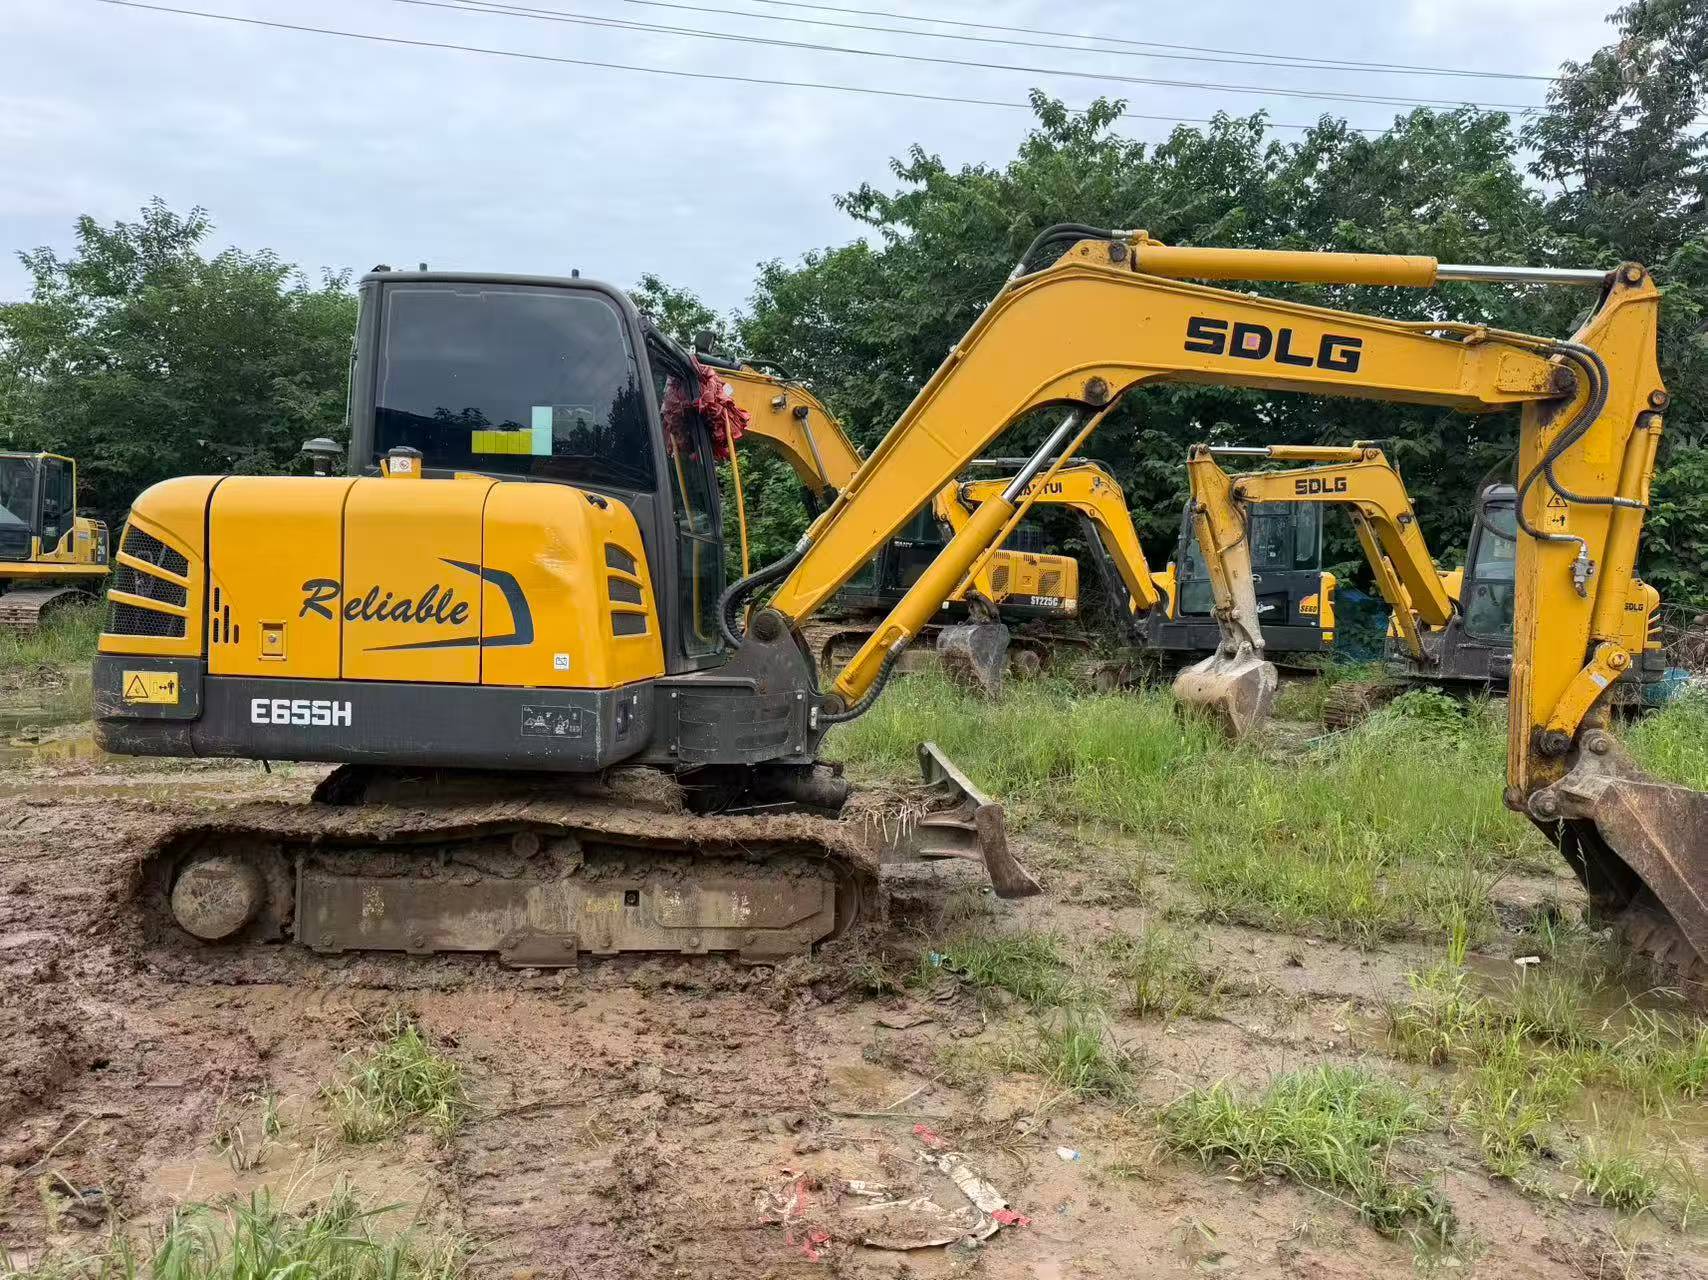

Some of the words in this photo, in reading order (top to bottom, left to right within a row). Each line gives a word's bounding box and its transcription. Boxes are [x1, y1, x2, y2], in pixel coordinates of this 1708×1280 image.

[1184, 316, 1363, 373] SDLG
[1295, 476, 1347, 495] SDLG
[299, 578, 469, 625] Reliable
[1624, 603, 1644, 611] SDLG
[251, 698, 352, 727] E655H
